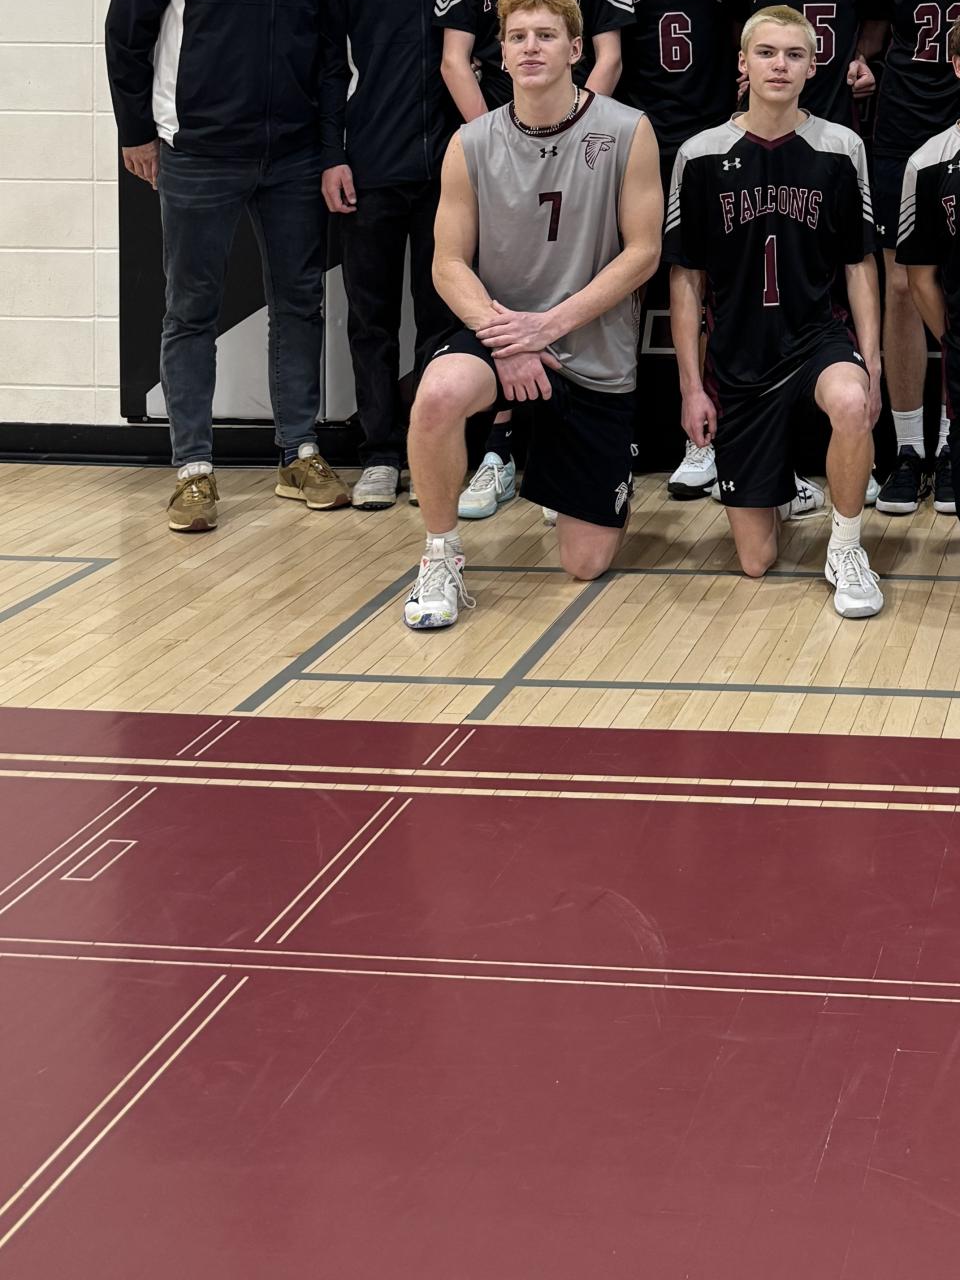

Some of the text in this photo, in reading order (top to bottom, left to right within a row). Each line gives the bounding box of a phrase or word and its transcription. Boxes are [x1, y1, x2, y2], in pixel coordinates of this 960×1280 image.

[658, 11, 693, 73] 6
[538, 190, 563, 242] 7
[719, 184, 823, 234] FALCONS
[763, 234, 780, 307] 1
